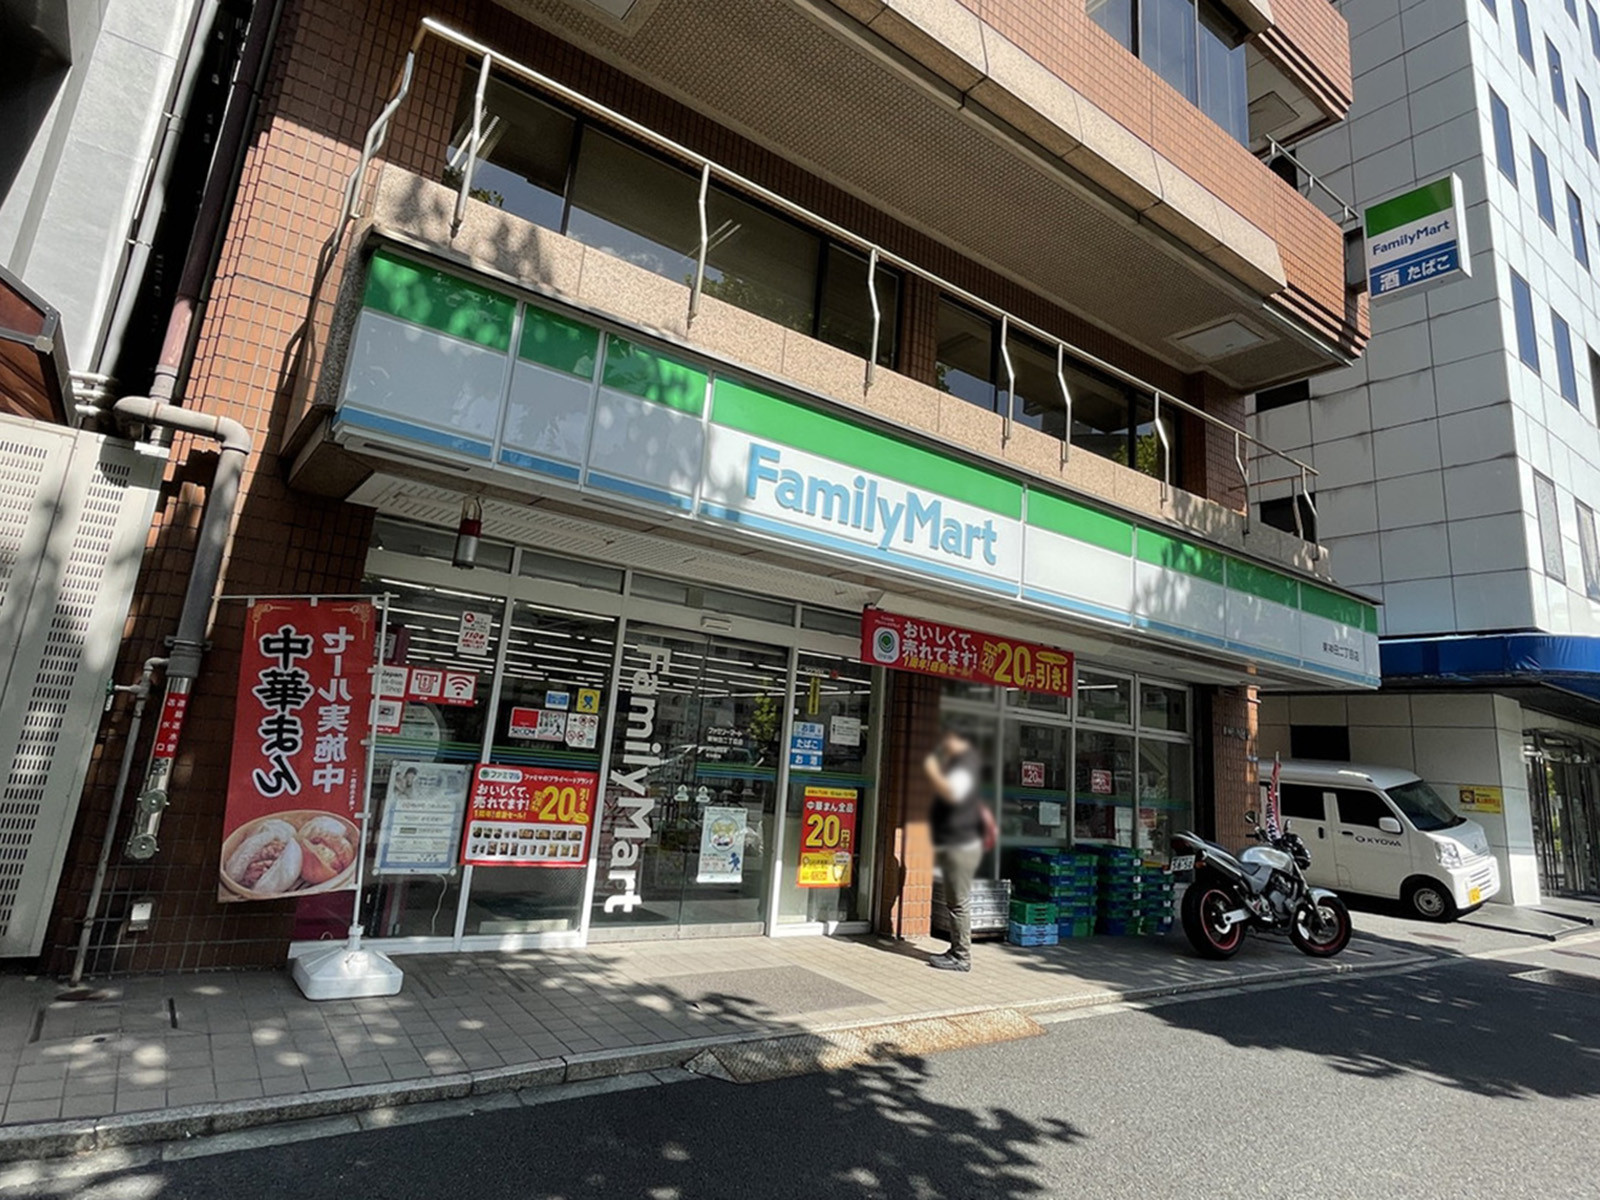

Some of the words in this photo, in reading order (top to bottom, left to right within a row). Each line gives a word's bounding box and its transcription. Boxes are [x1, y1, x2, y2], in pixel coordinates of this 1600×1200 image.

[1372, 220, 1450, 255] FamilyMart
[1380, 269, 1400, 292] 酒
[1407, 255, 1451, 281] たばこ
[746, 442, 998, 566] FamilyMart
[903, 621, 977, 651] おいしくて、
[477, 784, 530, 798] おいしくて、
[604, 644, 672, 914] FamilyMart
[806, 813, 840, 848] 20
